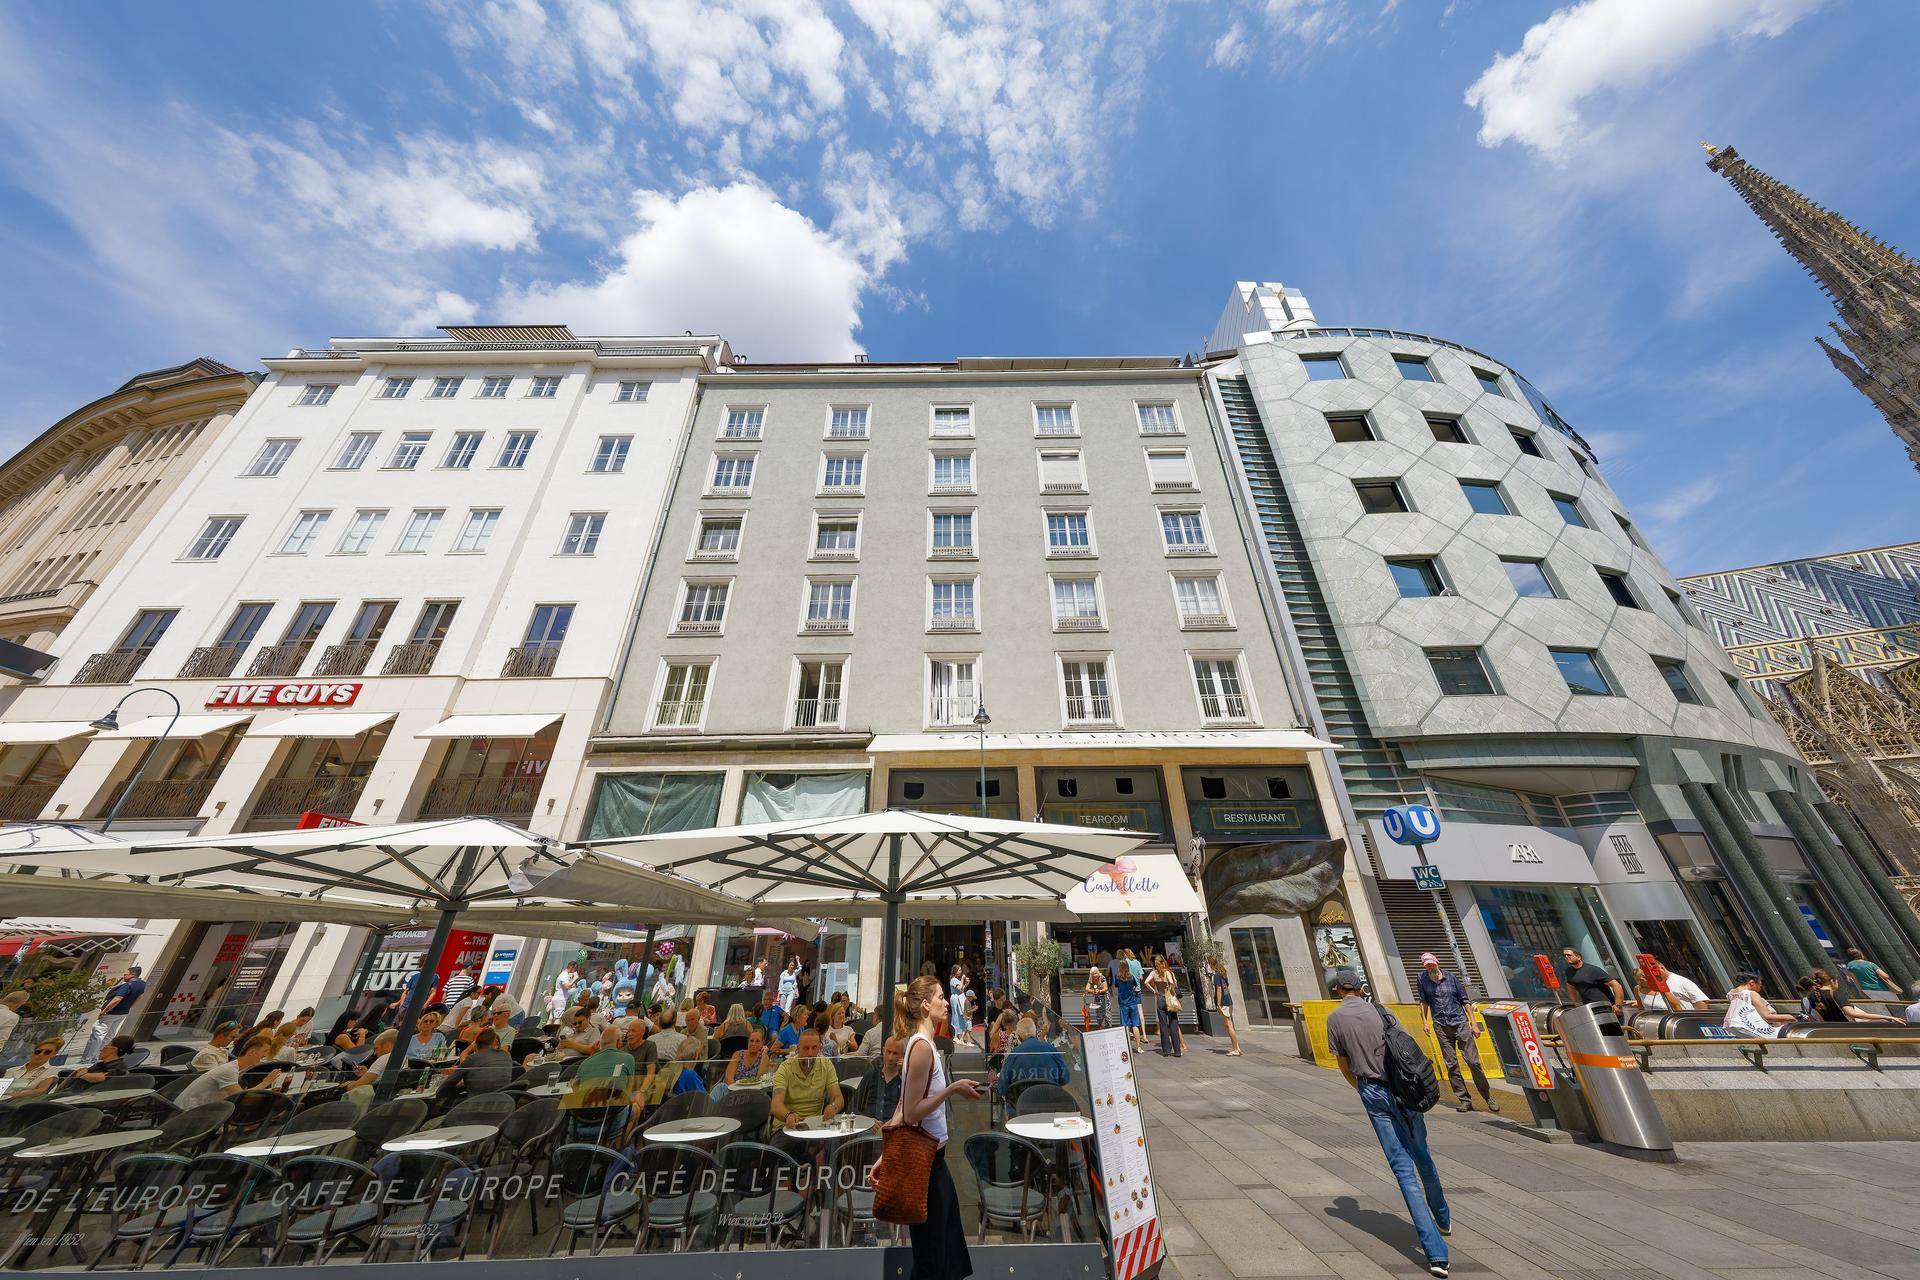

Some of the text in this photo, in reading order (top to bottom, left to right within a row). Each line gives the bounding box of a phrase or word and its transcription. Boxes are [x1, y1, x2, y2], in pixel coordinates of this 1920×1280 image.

[207, 684, 355, 704] FIVE GUYS
[1080, 815, 1129, 825] TEAROOM
[1224, 813, 1287, 824] RESTAURANT
[1384, 813, 1403, 838] U
[1409, 811, 1436, 835] U
[1415, 867, 1439, 879] WC
[1084, 874, 1160, 894] Castelletto
[384, 930, 428, 939] KSHAKES
[610, 1164, 874, 1197] CAFÉ DE L'EUROP
[11, 1188, 62, 1213] DE
[63, 1184, 227, 1213] L'EUROPE
[271, 1174, 565, 1208] CAFÉ DE L'EUROPE
[717, 1213, 741, 1226] Wien
[757, 1211, 785, 1226] 1952
[56, 1232, 87, 1247] 1952
